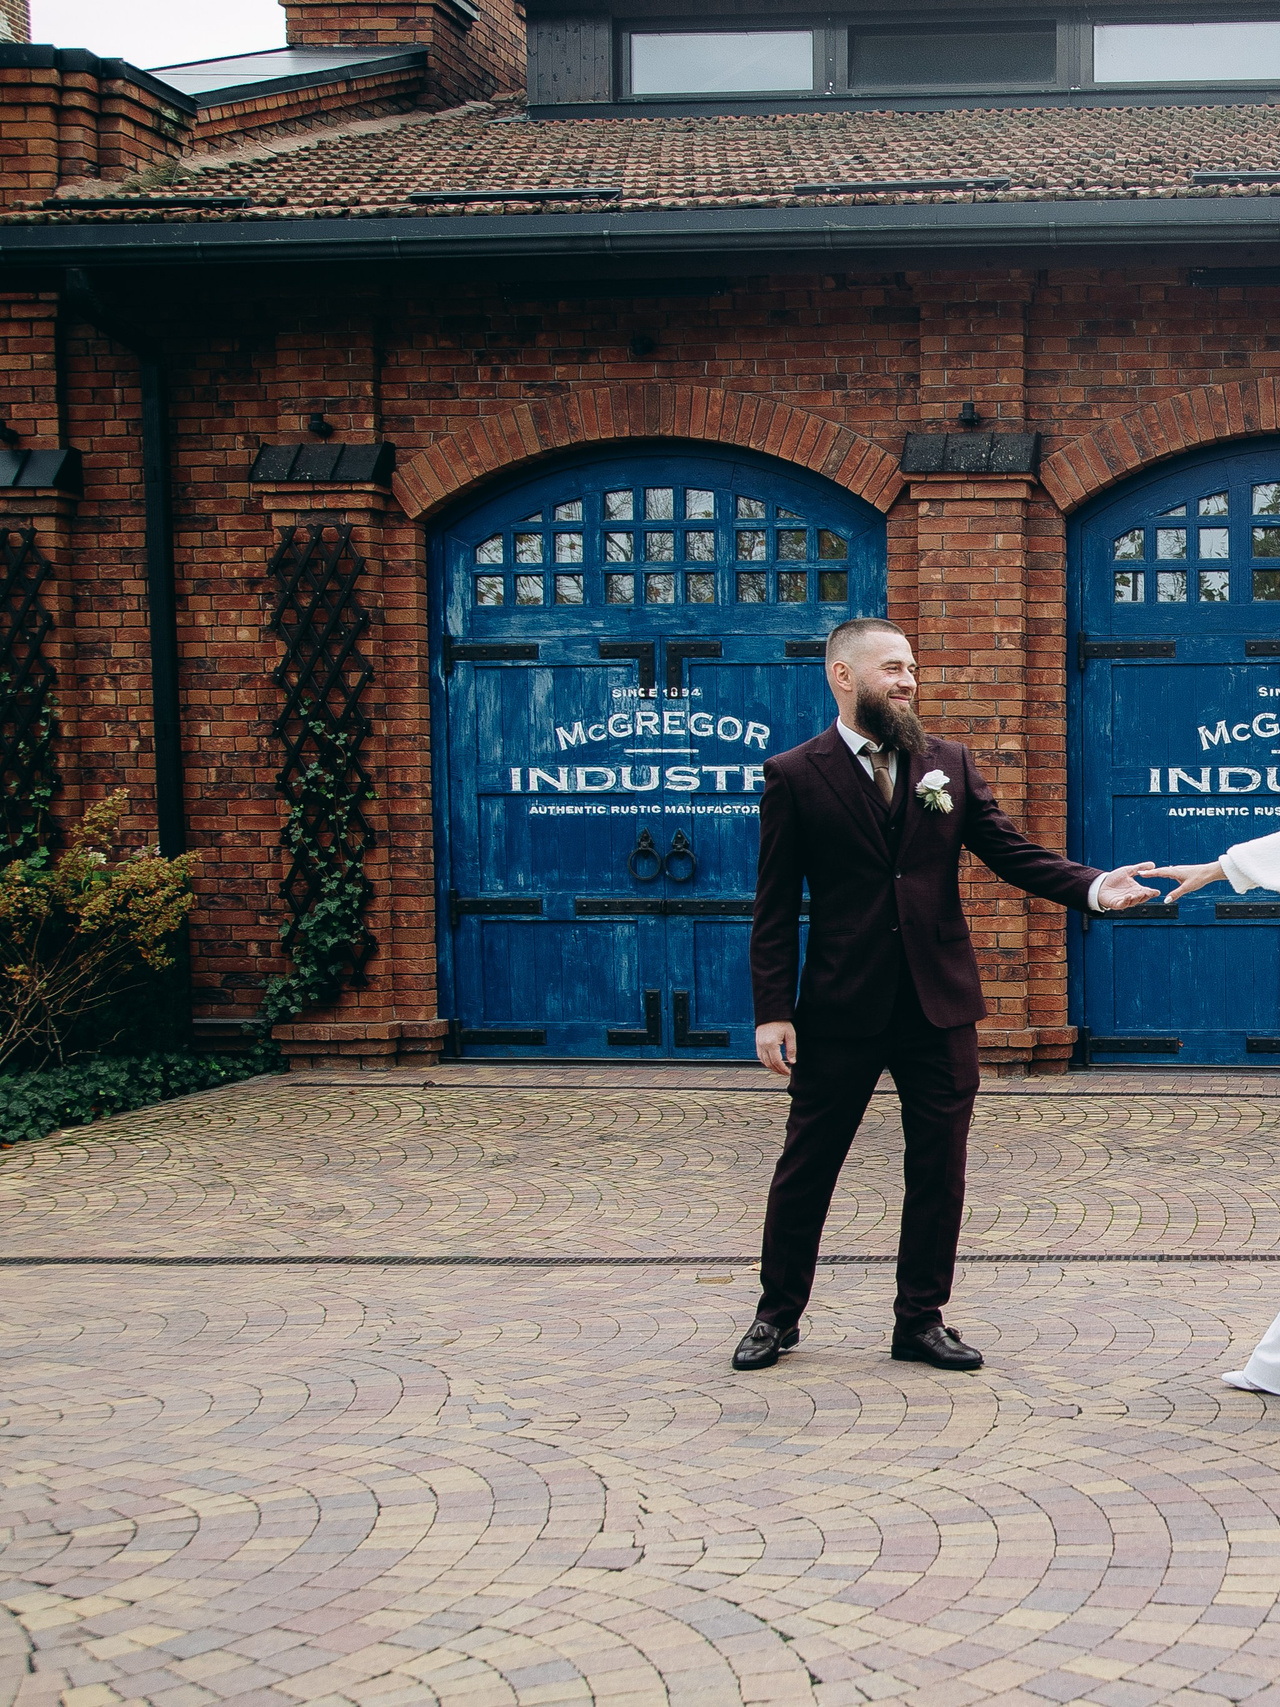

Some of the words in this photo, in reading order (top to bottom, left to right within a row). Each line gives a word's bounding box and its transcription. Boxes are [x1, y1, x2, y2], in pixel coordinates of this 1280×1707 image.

[611, 686, 658, 698] SINCE
[662, 686, 702, 698] 1894
[555, 711, 771, 751] McGREGOR
[529, 805, 606, 815] AUTHENTIC
[611, 805, 661, 815] RUSTIC
[664, 805, 760, 815] MANUFACTOR
[1168, 807, 1250, 816] AUTHENTIC
